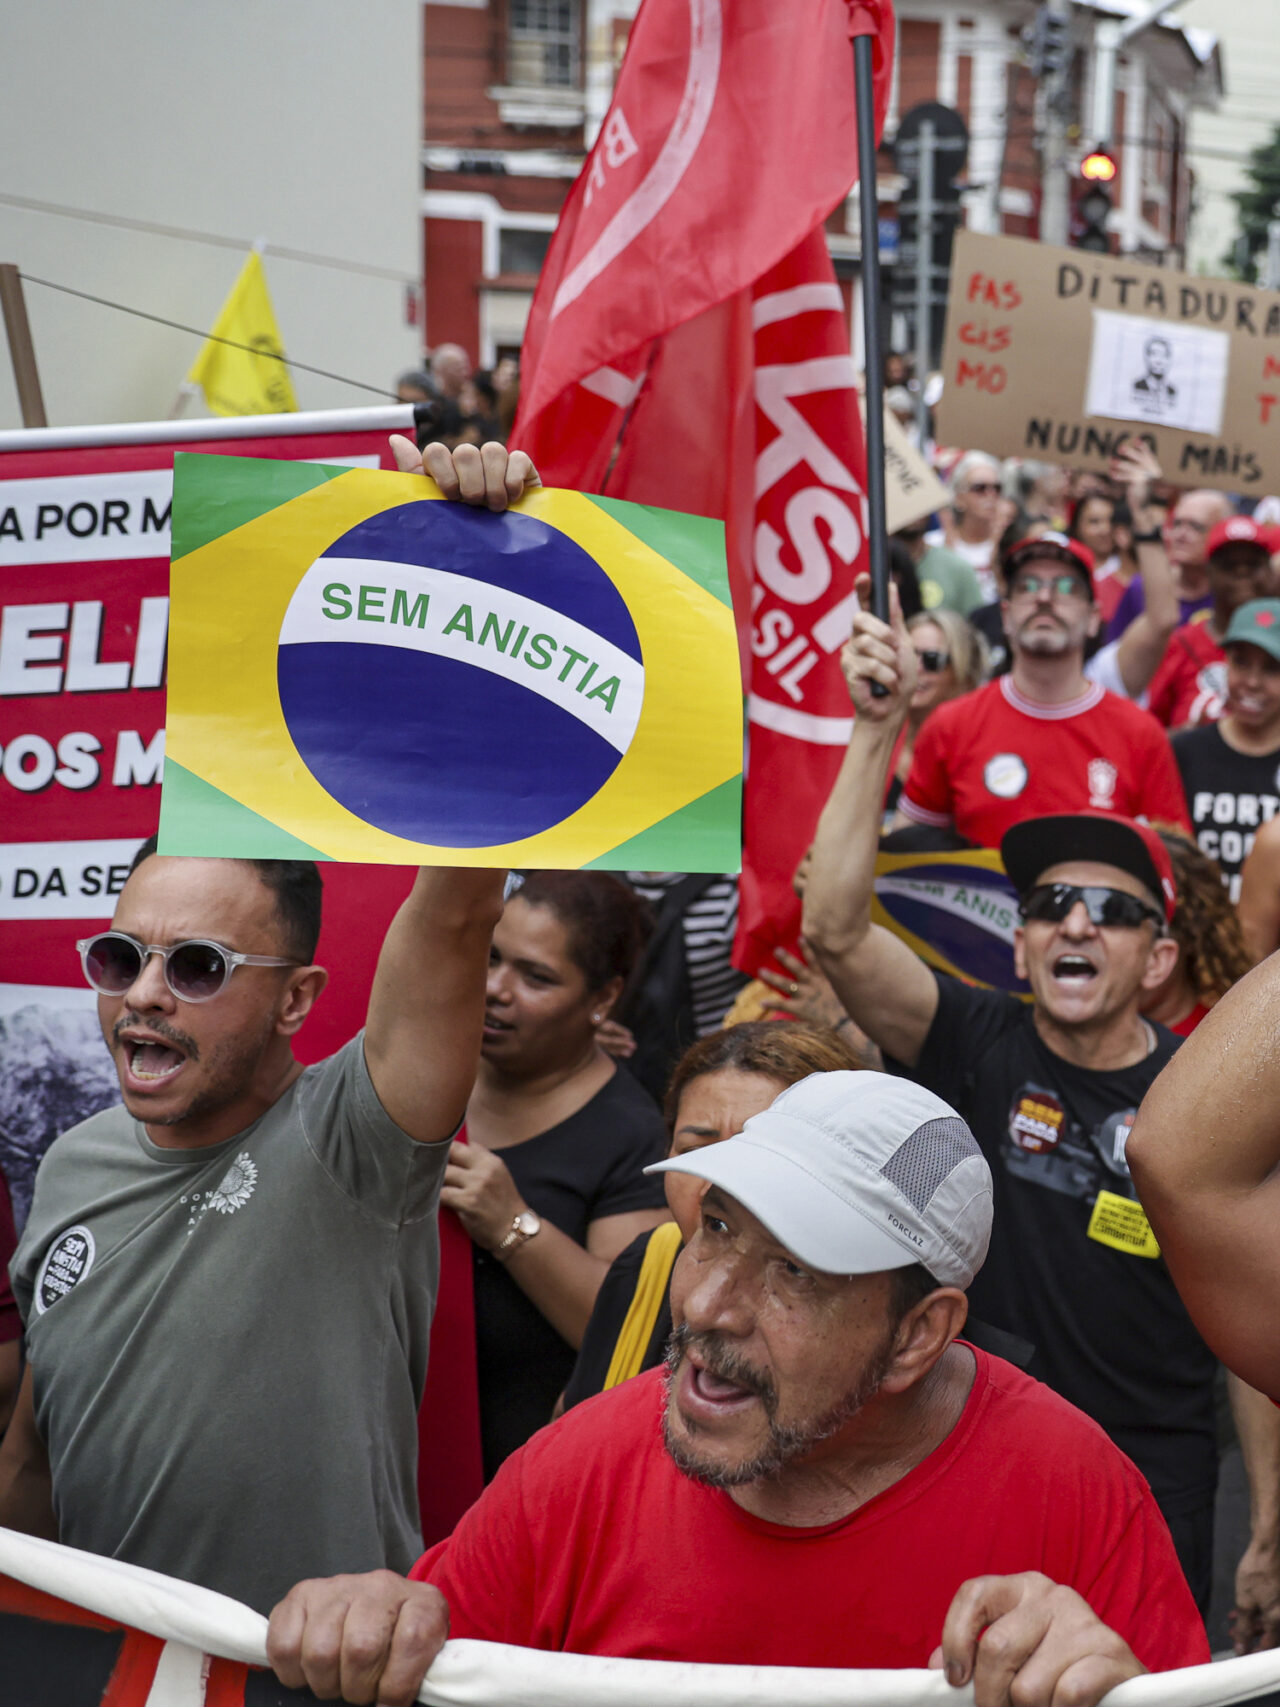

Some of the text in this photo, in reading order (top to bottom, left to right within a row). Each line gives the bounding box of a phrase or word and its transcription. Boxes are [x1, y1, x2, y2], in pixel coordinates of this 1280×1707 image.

[955, 358, 1008, 395] MO
[36, 500, 130, 539] POR
[321, 582, 622, 714] SEM ANISTIA
[0, 731, 103, 793] OS
[13, 868, 67, 898] DA
[62, 1237, 86, 1258] SEM
[887, 1213, 924, 1247] FORCLAZ
